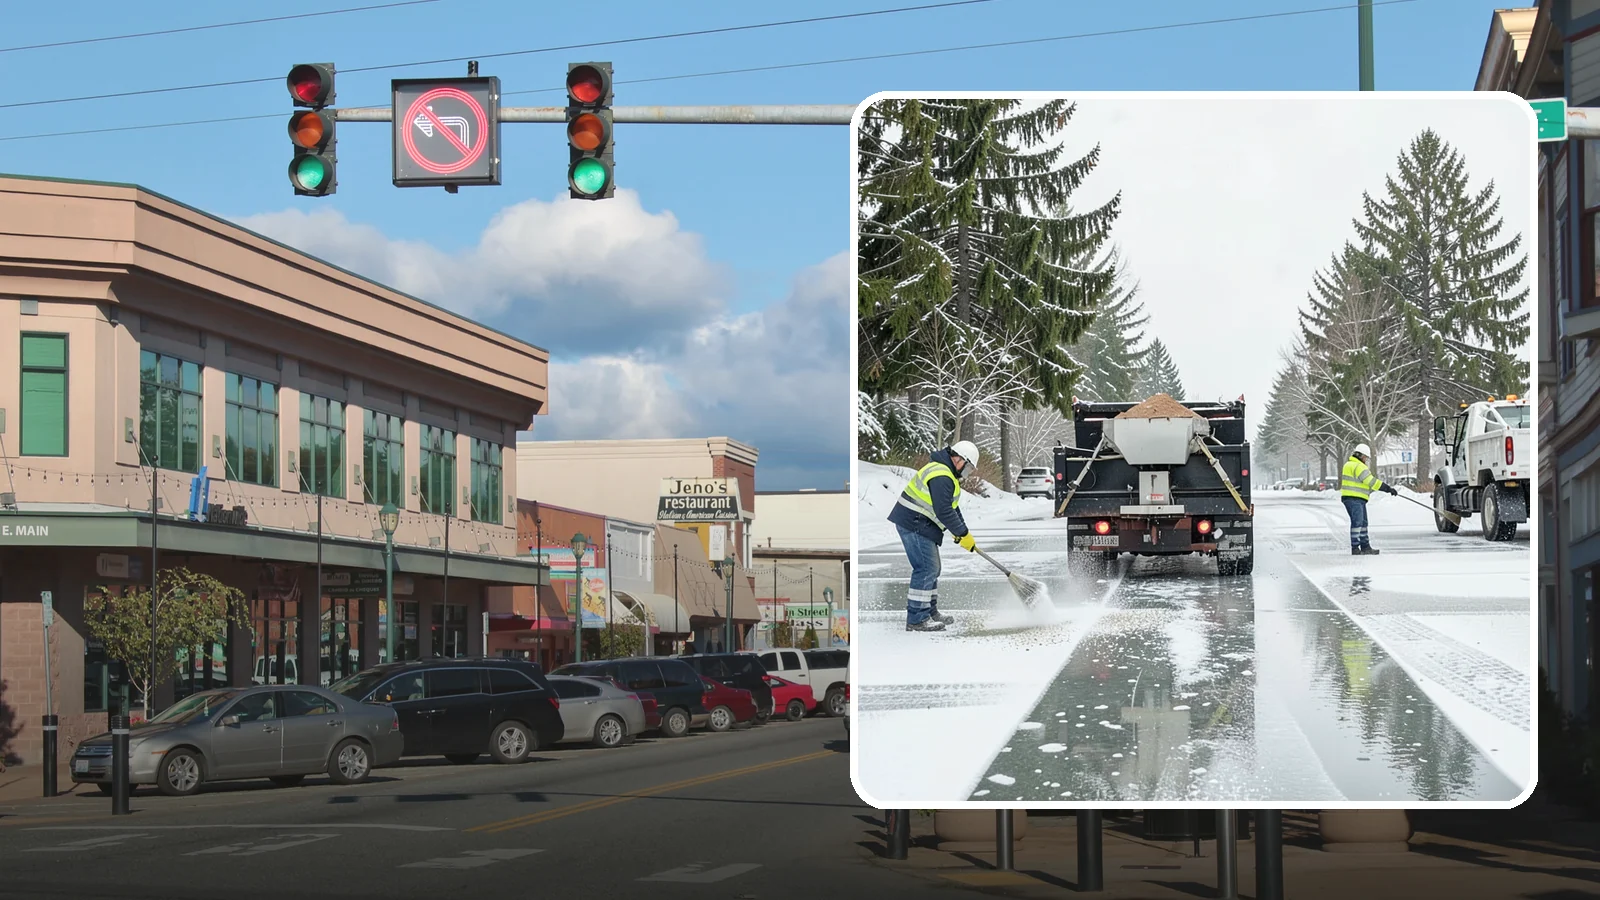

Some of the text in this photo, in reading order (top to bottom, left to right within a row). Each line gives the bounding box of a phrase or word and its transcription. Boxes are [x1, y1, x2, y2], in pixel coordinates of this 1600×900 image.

[670, 480, 727, 494] Jeno's
[665, 496, 731, 509] restaurant
[658, 509, 681, 519] Italian
[685, 509, 714, 519] American
[714, 509, 738, 519] Cuisine
[2, 525, 49, 536] E. MAIN
[797, 608, 828, 617] Street
